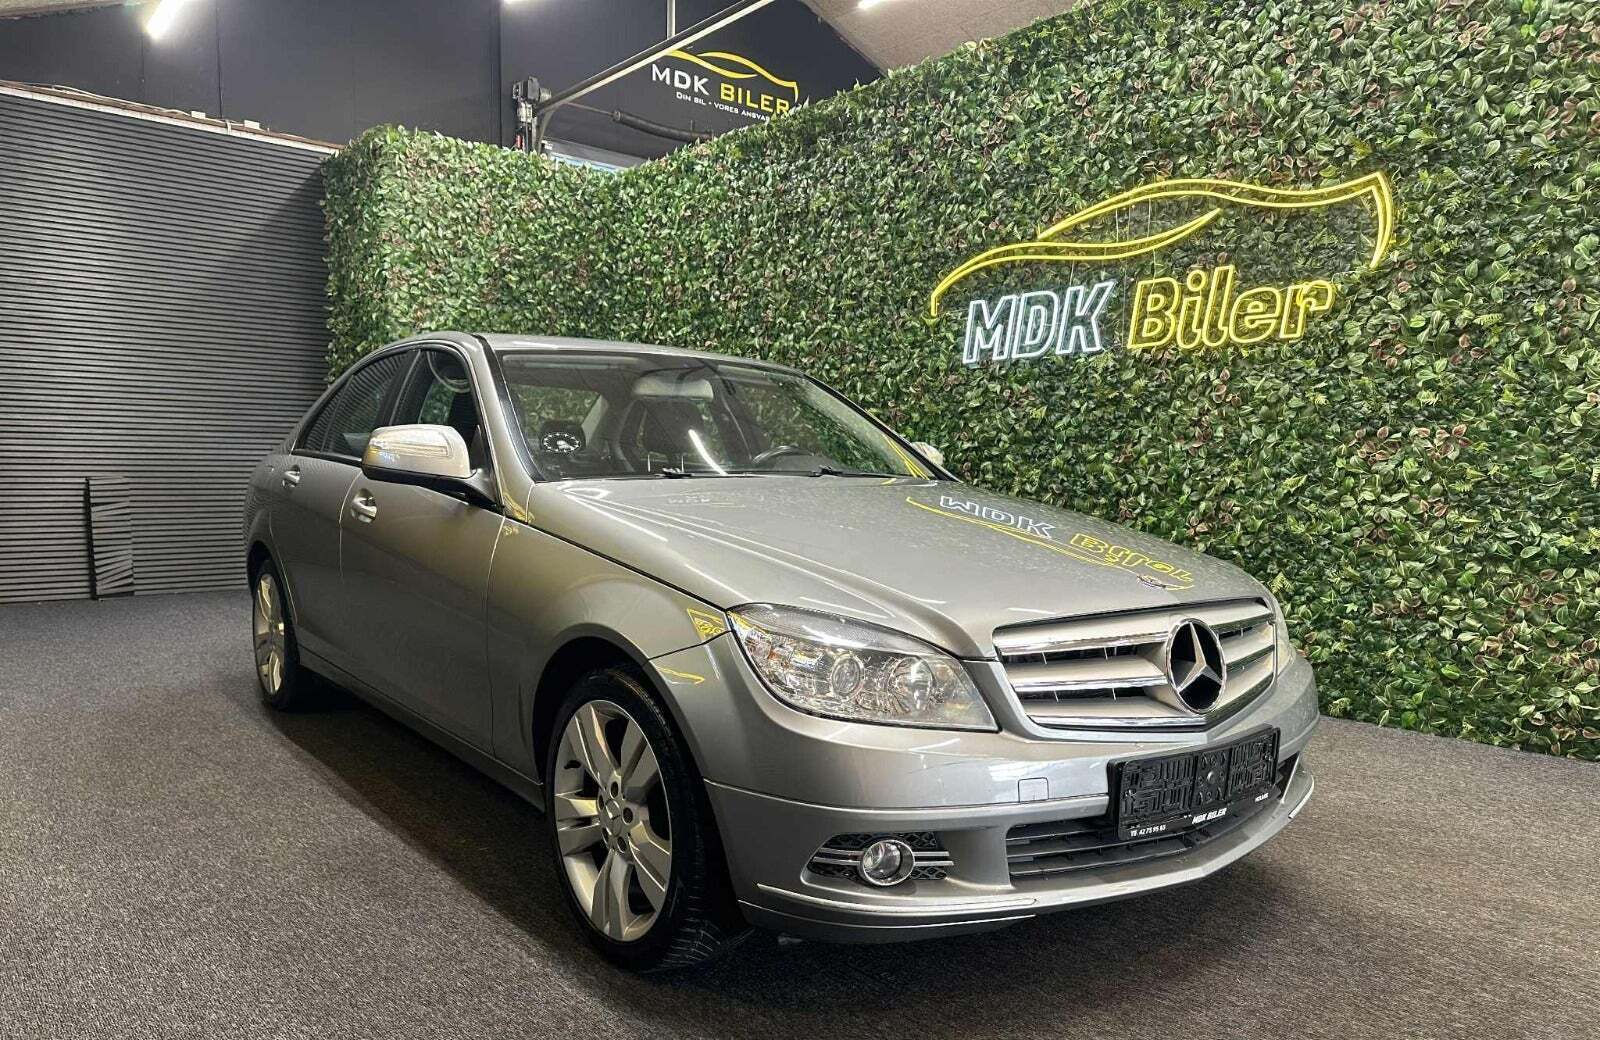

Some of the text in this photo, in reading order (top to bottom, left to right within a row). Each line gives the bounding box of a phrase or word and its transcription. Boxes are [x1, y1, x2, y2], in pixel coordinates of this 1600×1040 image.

[652, 64, 790, 115] MDK BILER
[962, 265, 1334, 364] MDK Biler
